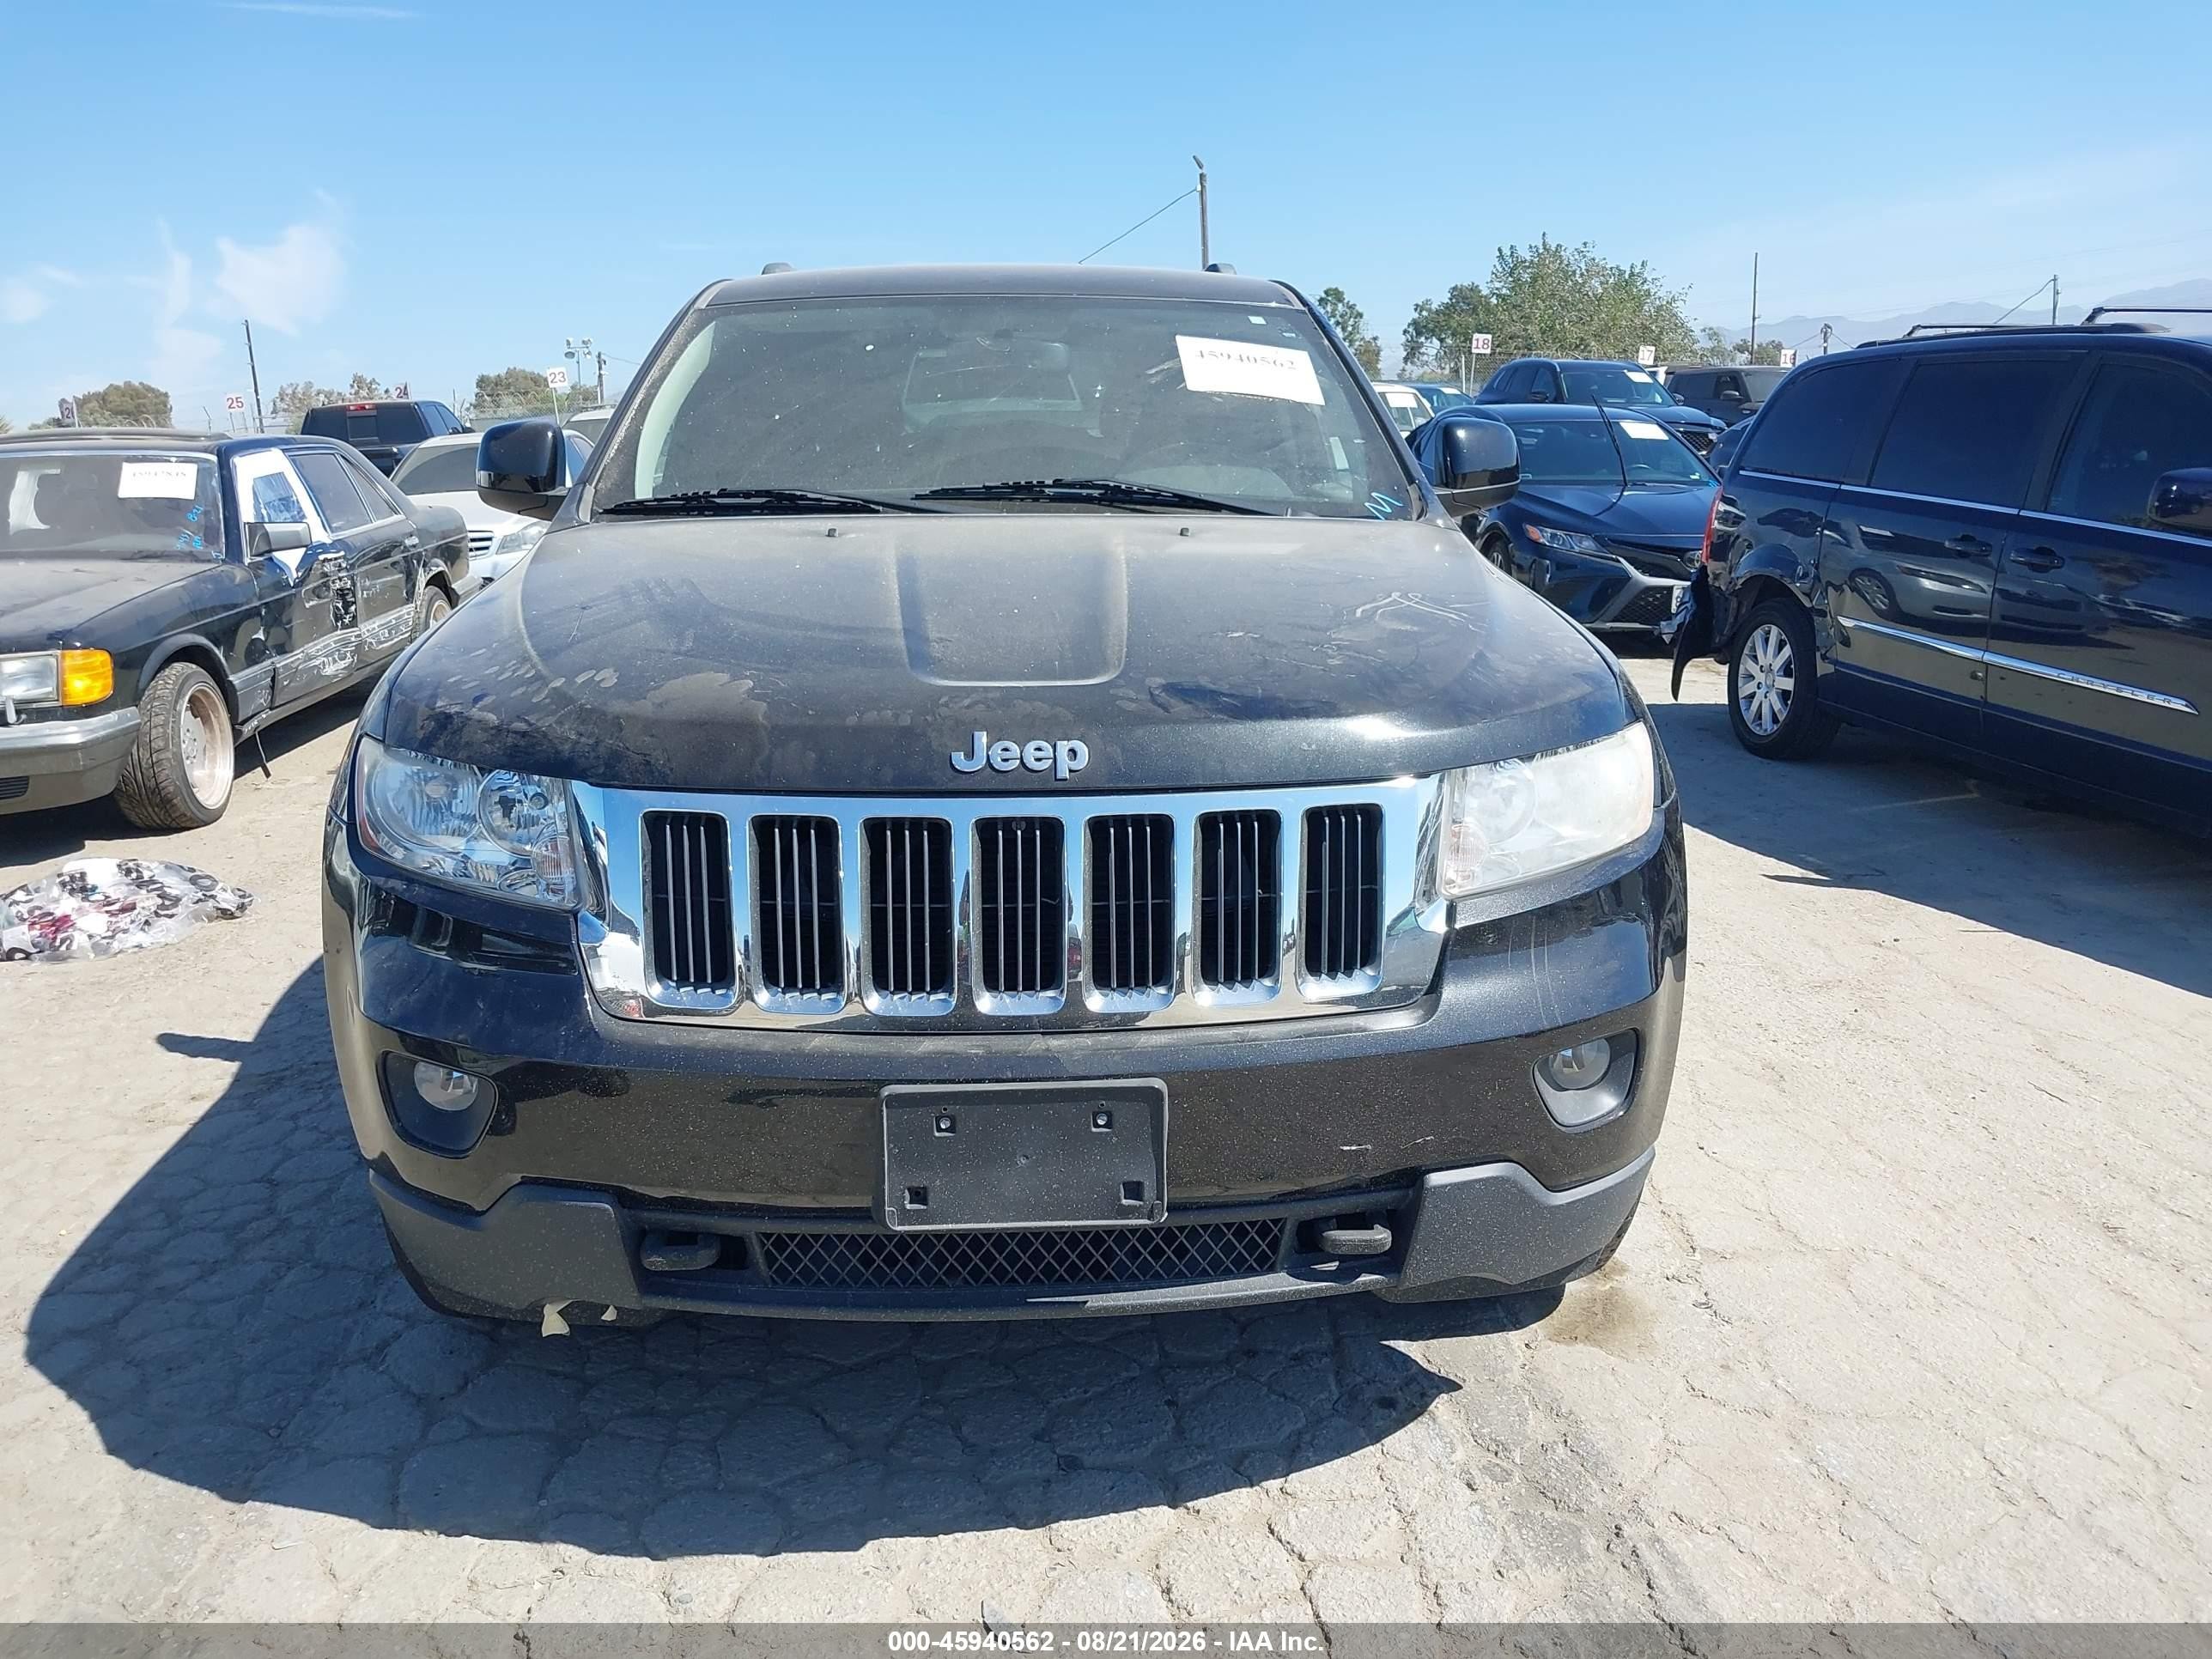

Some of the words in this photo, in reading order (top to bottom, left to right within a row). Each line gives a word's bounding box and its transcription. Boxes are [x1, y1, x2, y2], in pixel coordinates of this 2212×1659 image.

[1473, 337, 1490, 349] 18
[1640, 349, 1653, 361] 17
[550, 371, 567, 383] 23
[227, 397, 244, 409] 25
[2056, 672, 2172, 706] CHRYSLER
[951, 731, 1090, 781] Jeep
